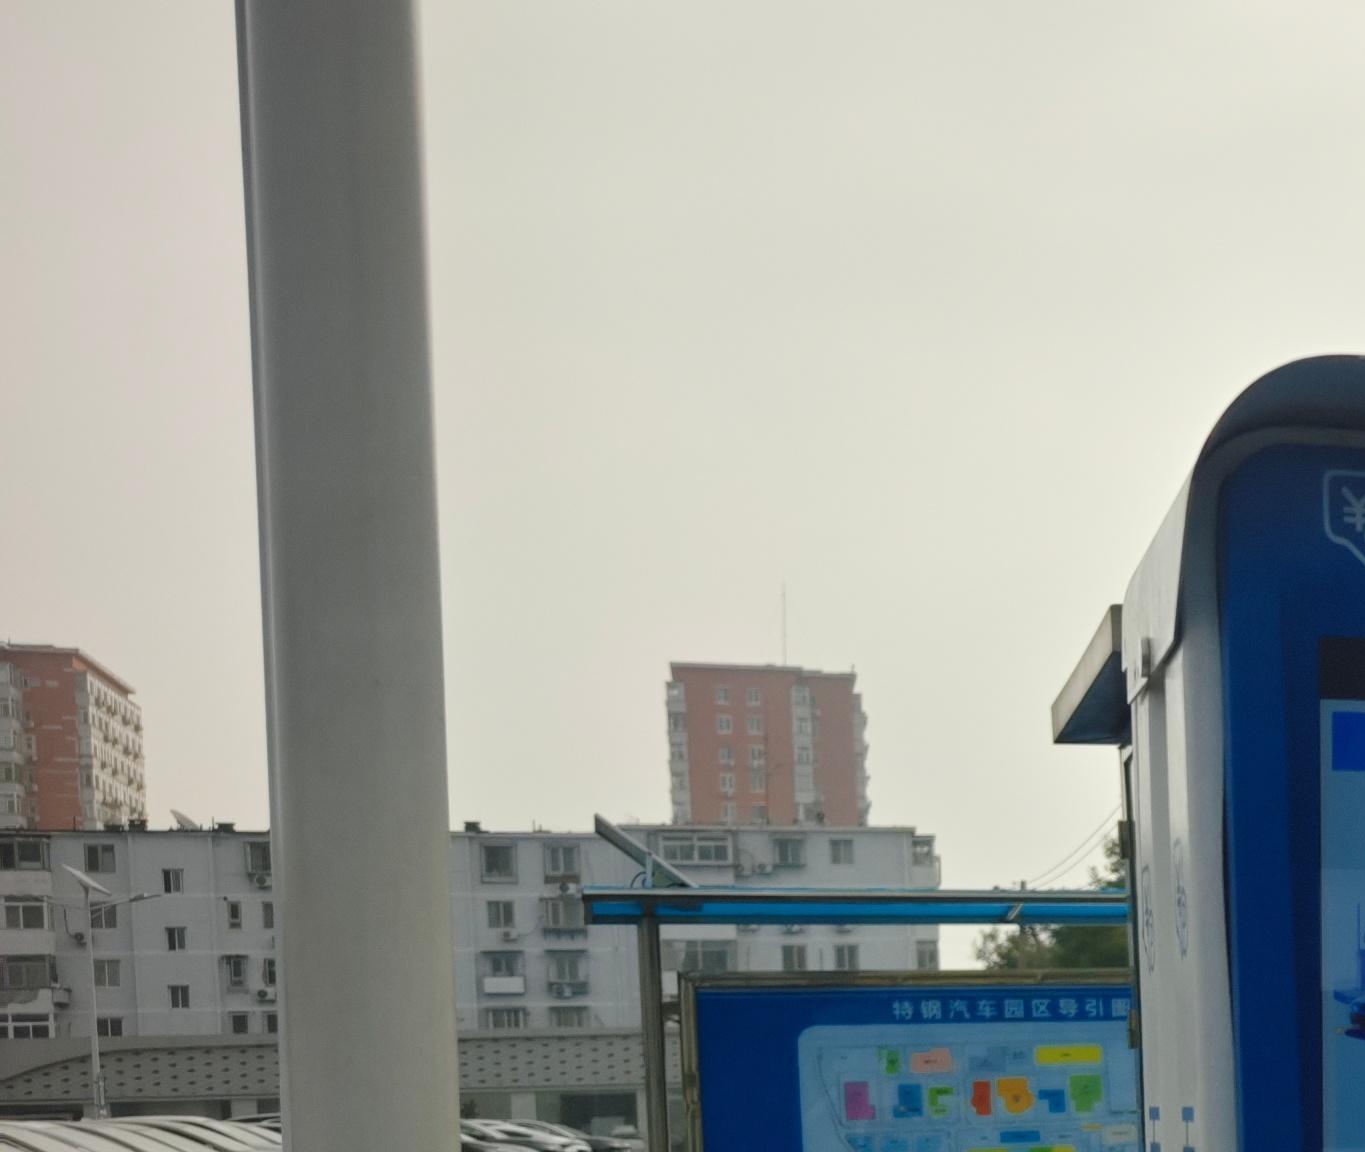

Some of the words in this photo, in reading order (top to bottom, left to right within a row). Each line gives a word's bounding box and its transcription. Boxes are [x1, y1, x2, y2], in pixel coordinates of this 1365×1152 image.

[891, 996, 1131, 1022] 特钢汽车园区导引图
